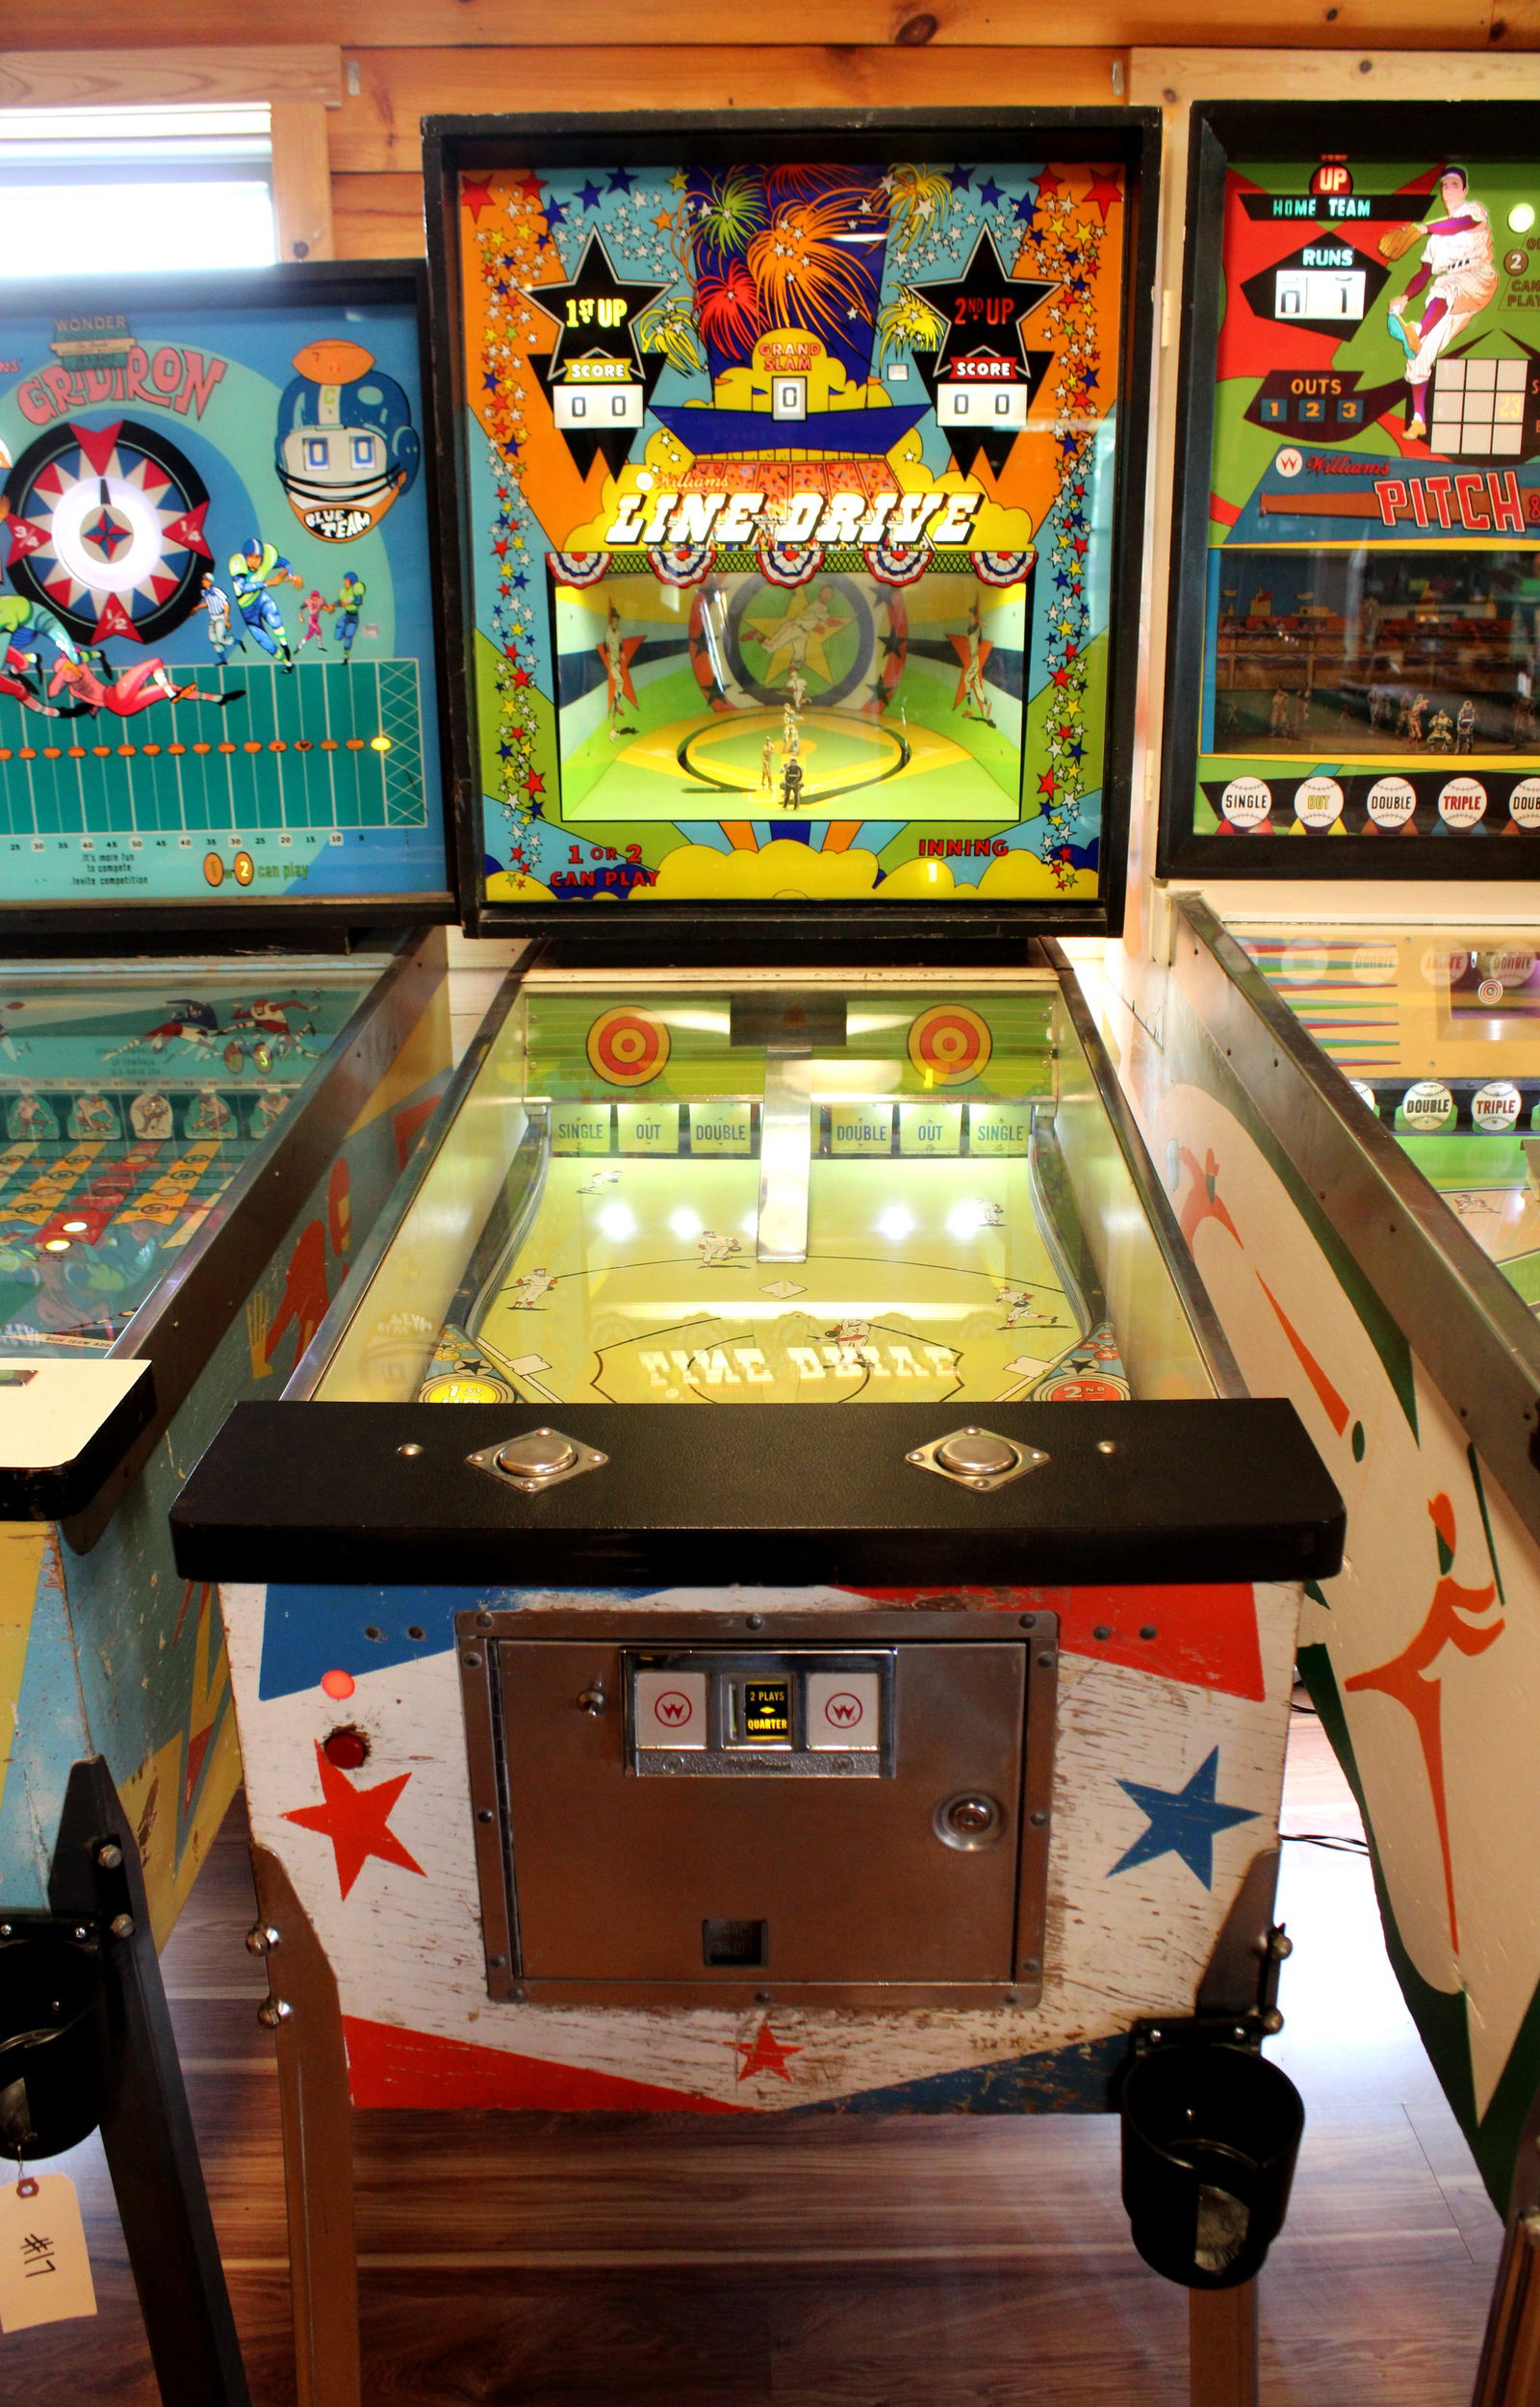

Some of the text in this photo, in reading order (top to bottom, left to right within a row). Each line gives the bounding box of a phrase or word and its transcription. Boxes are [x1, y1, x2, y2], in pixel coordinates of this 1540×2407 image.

[1320, 168, 1348, 192] UP
[1272, 198, 1372, 218] HOME TEAM
[1301, 248, 1354, 268] RUNS
[1510, 253, 1523, 271] 2
[598, 298, 629, 328] UP
[987, 298, 1014, 324] UP
[55, 315, 126, 332] WONDER
[757, 342, 821, 356] GRAND
[571, 364, 625, 377] SCORE
[763, 357, 812, 372] SLAM
[956, 361, 1011, 377] SCORE
[17, 346, 228, 426] GRIDIRON
[1291, 378, 1342, 396] OUTS
[783, 386, 798, 407] 0
[954, 393, 1010, 415] 0 0
[572, 395, 626, 418] 0 0
[1270, 401, 1356, 418] 1 2 3
[308, 436, 373, 467] 0 0
[1305, 454, 1391, 477] Williams
[654, 470, 729, 489] Williams
[1374, 470, 1526, 533] PITCH
[304, 509, 346, 528] BLUE
[321, 511, 371, 539] TEAM
[603, 491, 986, 546] LINE DRIVE
[1225, 793, 1268, 810] SINGLE
[1306, 793, 1331, 811] OUT
[1371, 795, 1412, 811] DOUBLE
[1443, 795, 1481, 811] TRIPLE
[568, 843, 643, 864] 1 OR 2
[918, 838, 1010, 858] INNING
[550, 870, 661, 887] CAN PLAY
[927, 862, 937, 883] 1
[1407, 1099, 1516, 1115] DOUBLE TRIPLE
[558, 1123, 746, 1141] SINGLE OUT DOUBLE
[836, 1125, 1024, 1142] DOUBLE OUT SINGLE
[758, 1691, 784, 1702] PLAYS
[747, 1718, 788, 1731] QUARTER
